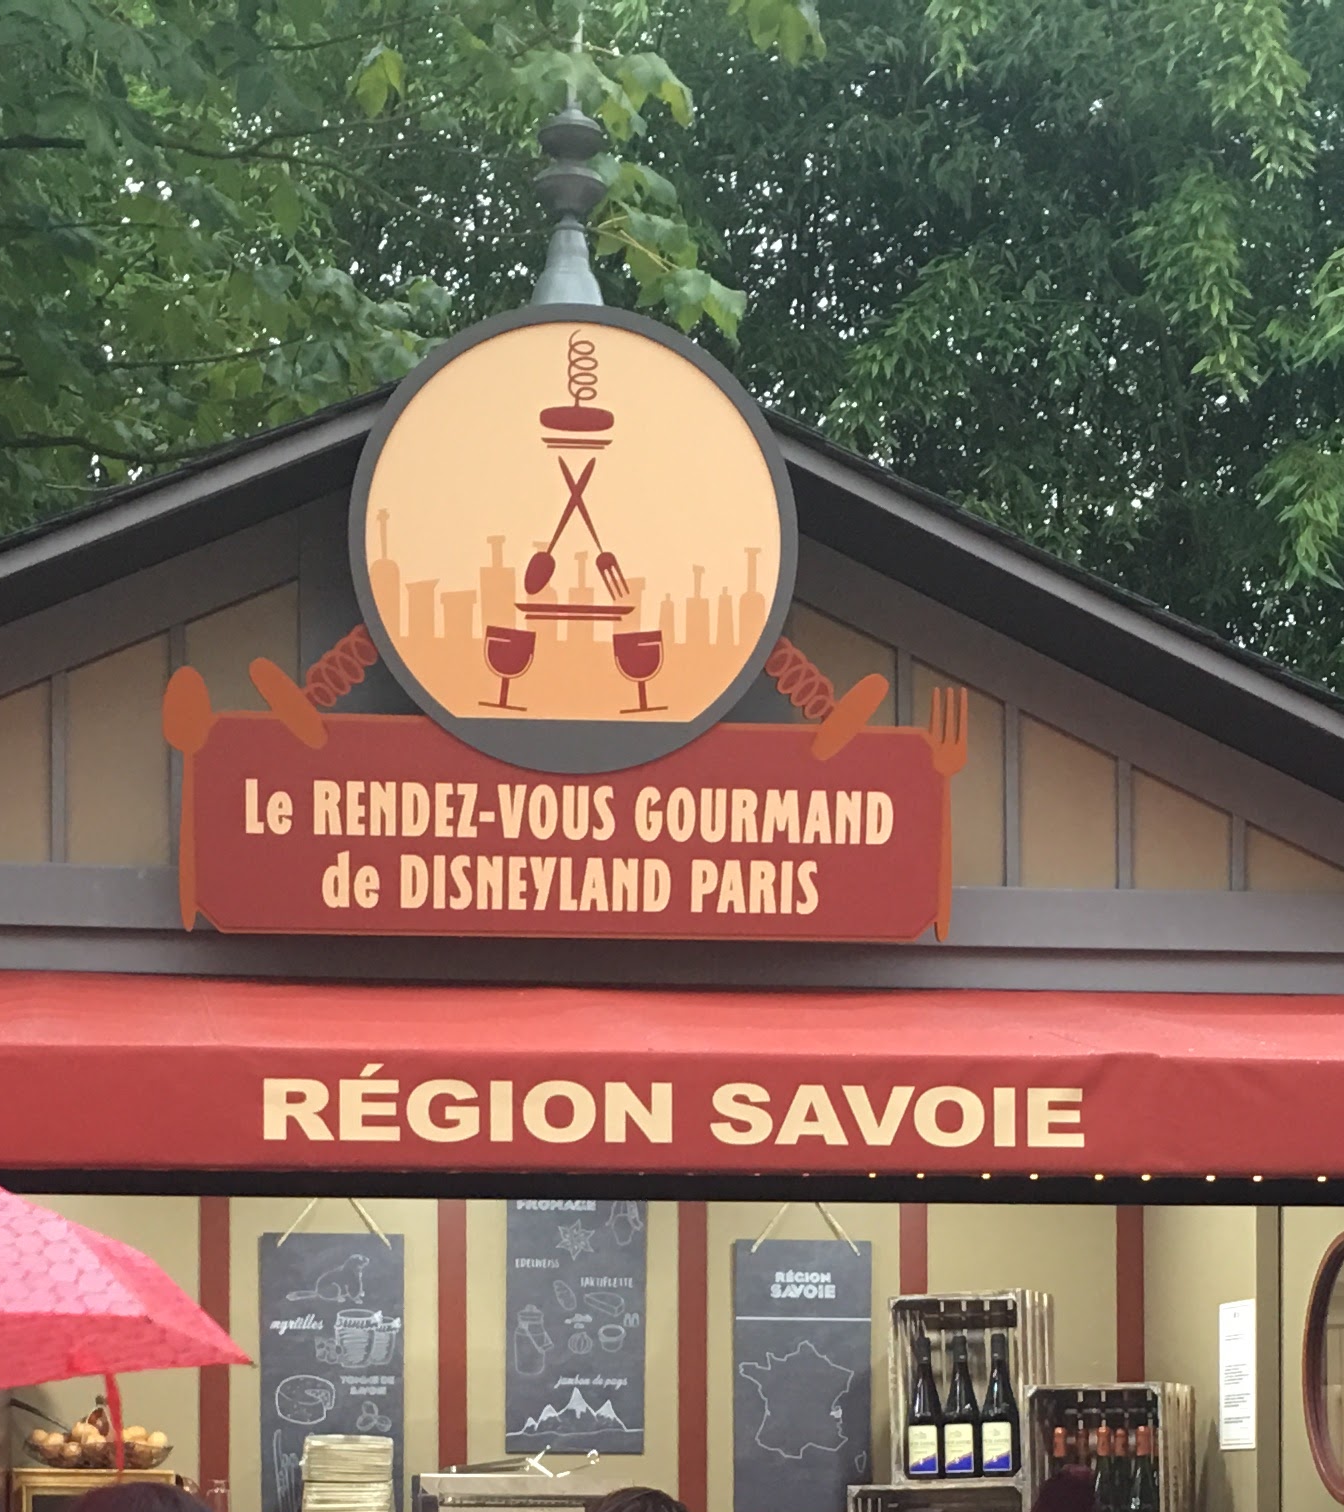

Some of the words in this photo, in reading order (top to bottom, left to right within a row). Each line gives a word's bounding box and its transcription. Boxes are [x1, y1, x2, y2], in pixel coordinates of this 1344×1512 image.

[245, 778, 293, 835] Le
[313, 780, 616, 841] RENDEZ-VOUS
[634, 786, 894, 845] GOURMAND
[321, 850, 380, 909] de
[400, 854, 672, 913] DISNEYLAND
[690, 859, 819, 915] PARIS
[262, 1064, 674, 1143] RÉGION
[709, 1084, 1086, 1149] SAVOIE
[514, 1258, 560, 1268] EDELWEISS
[774, 1269, 832, 1283] RÉGION
[770, 1284, 836, 1299] SAVOIE
[269, 1314, 324, 1335] myrtilles
